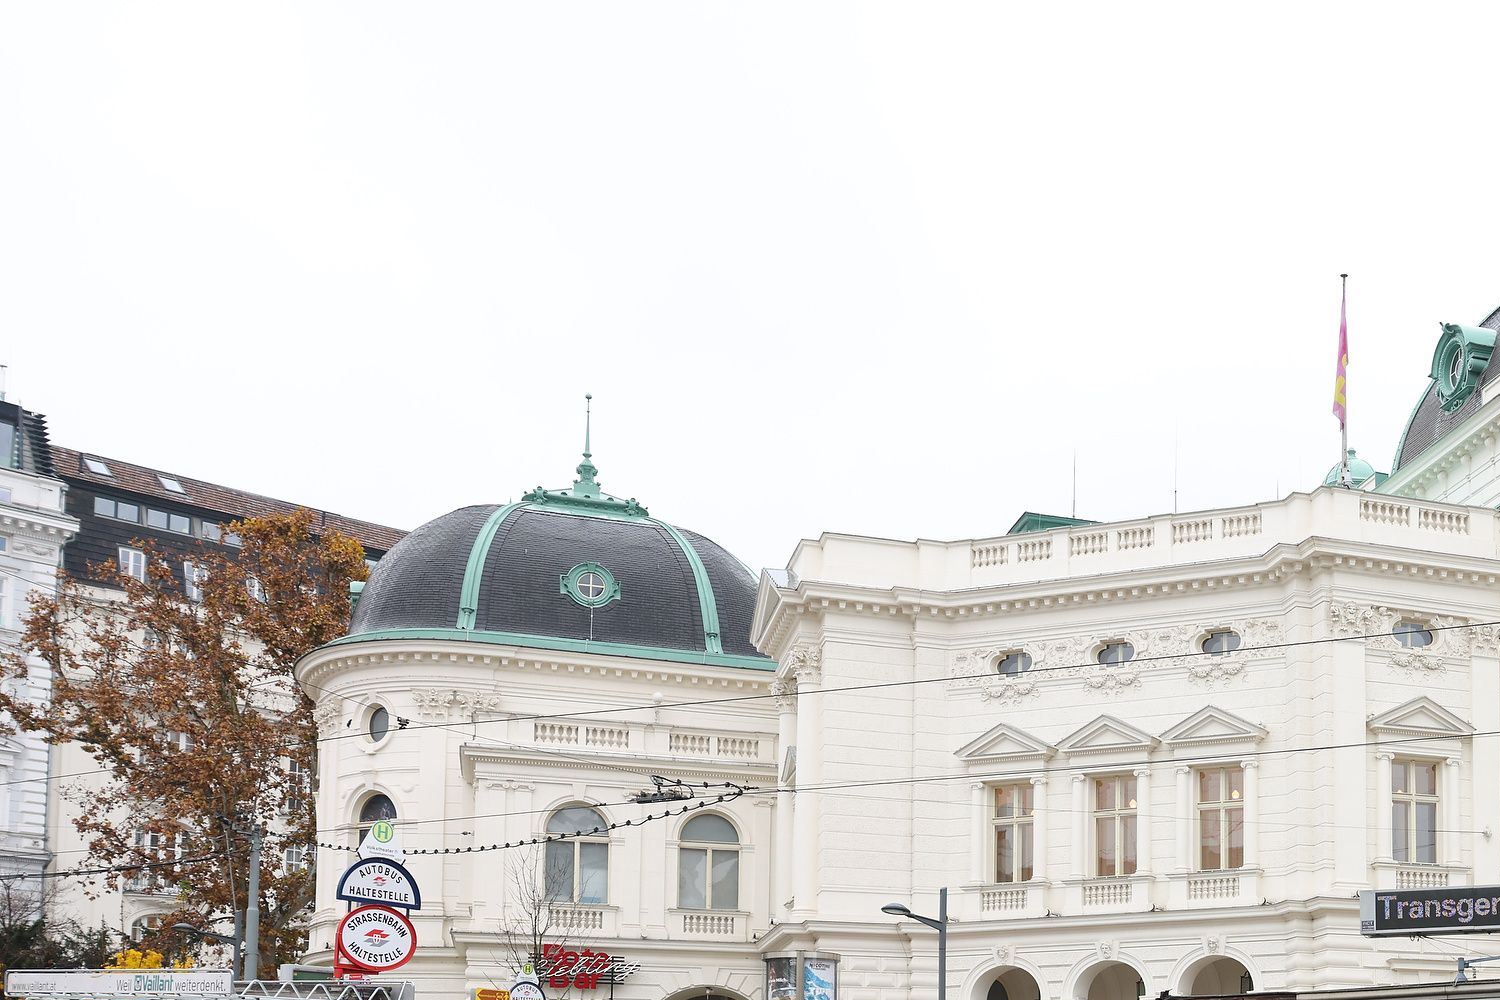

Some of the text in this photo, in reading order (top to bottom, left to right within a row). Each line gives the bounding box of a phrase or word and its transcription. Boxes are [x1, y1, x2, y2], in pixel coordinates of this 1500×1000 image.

[359, 865, 403, 884] AUTOBUS
[349, 885, 409, 902] HALTESTELLE
[347, 912, 408, 938] STRASSENBAHN
[348, 941, 404, 963] HALTESTELLE
[11, 981, 57, 992] www.vaillant.at
[116, 975, 227, 992] Weil Vaillant weiterdenkt.
[517, 985, 538, 994] AUTOBUS
